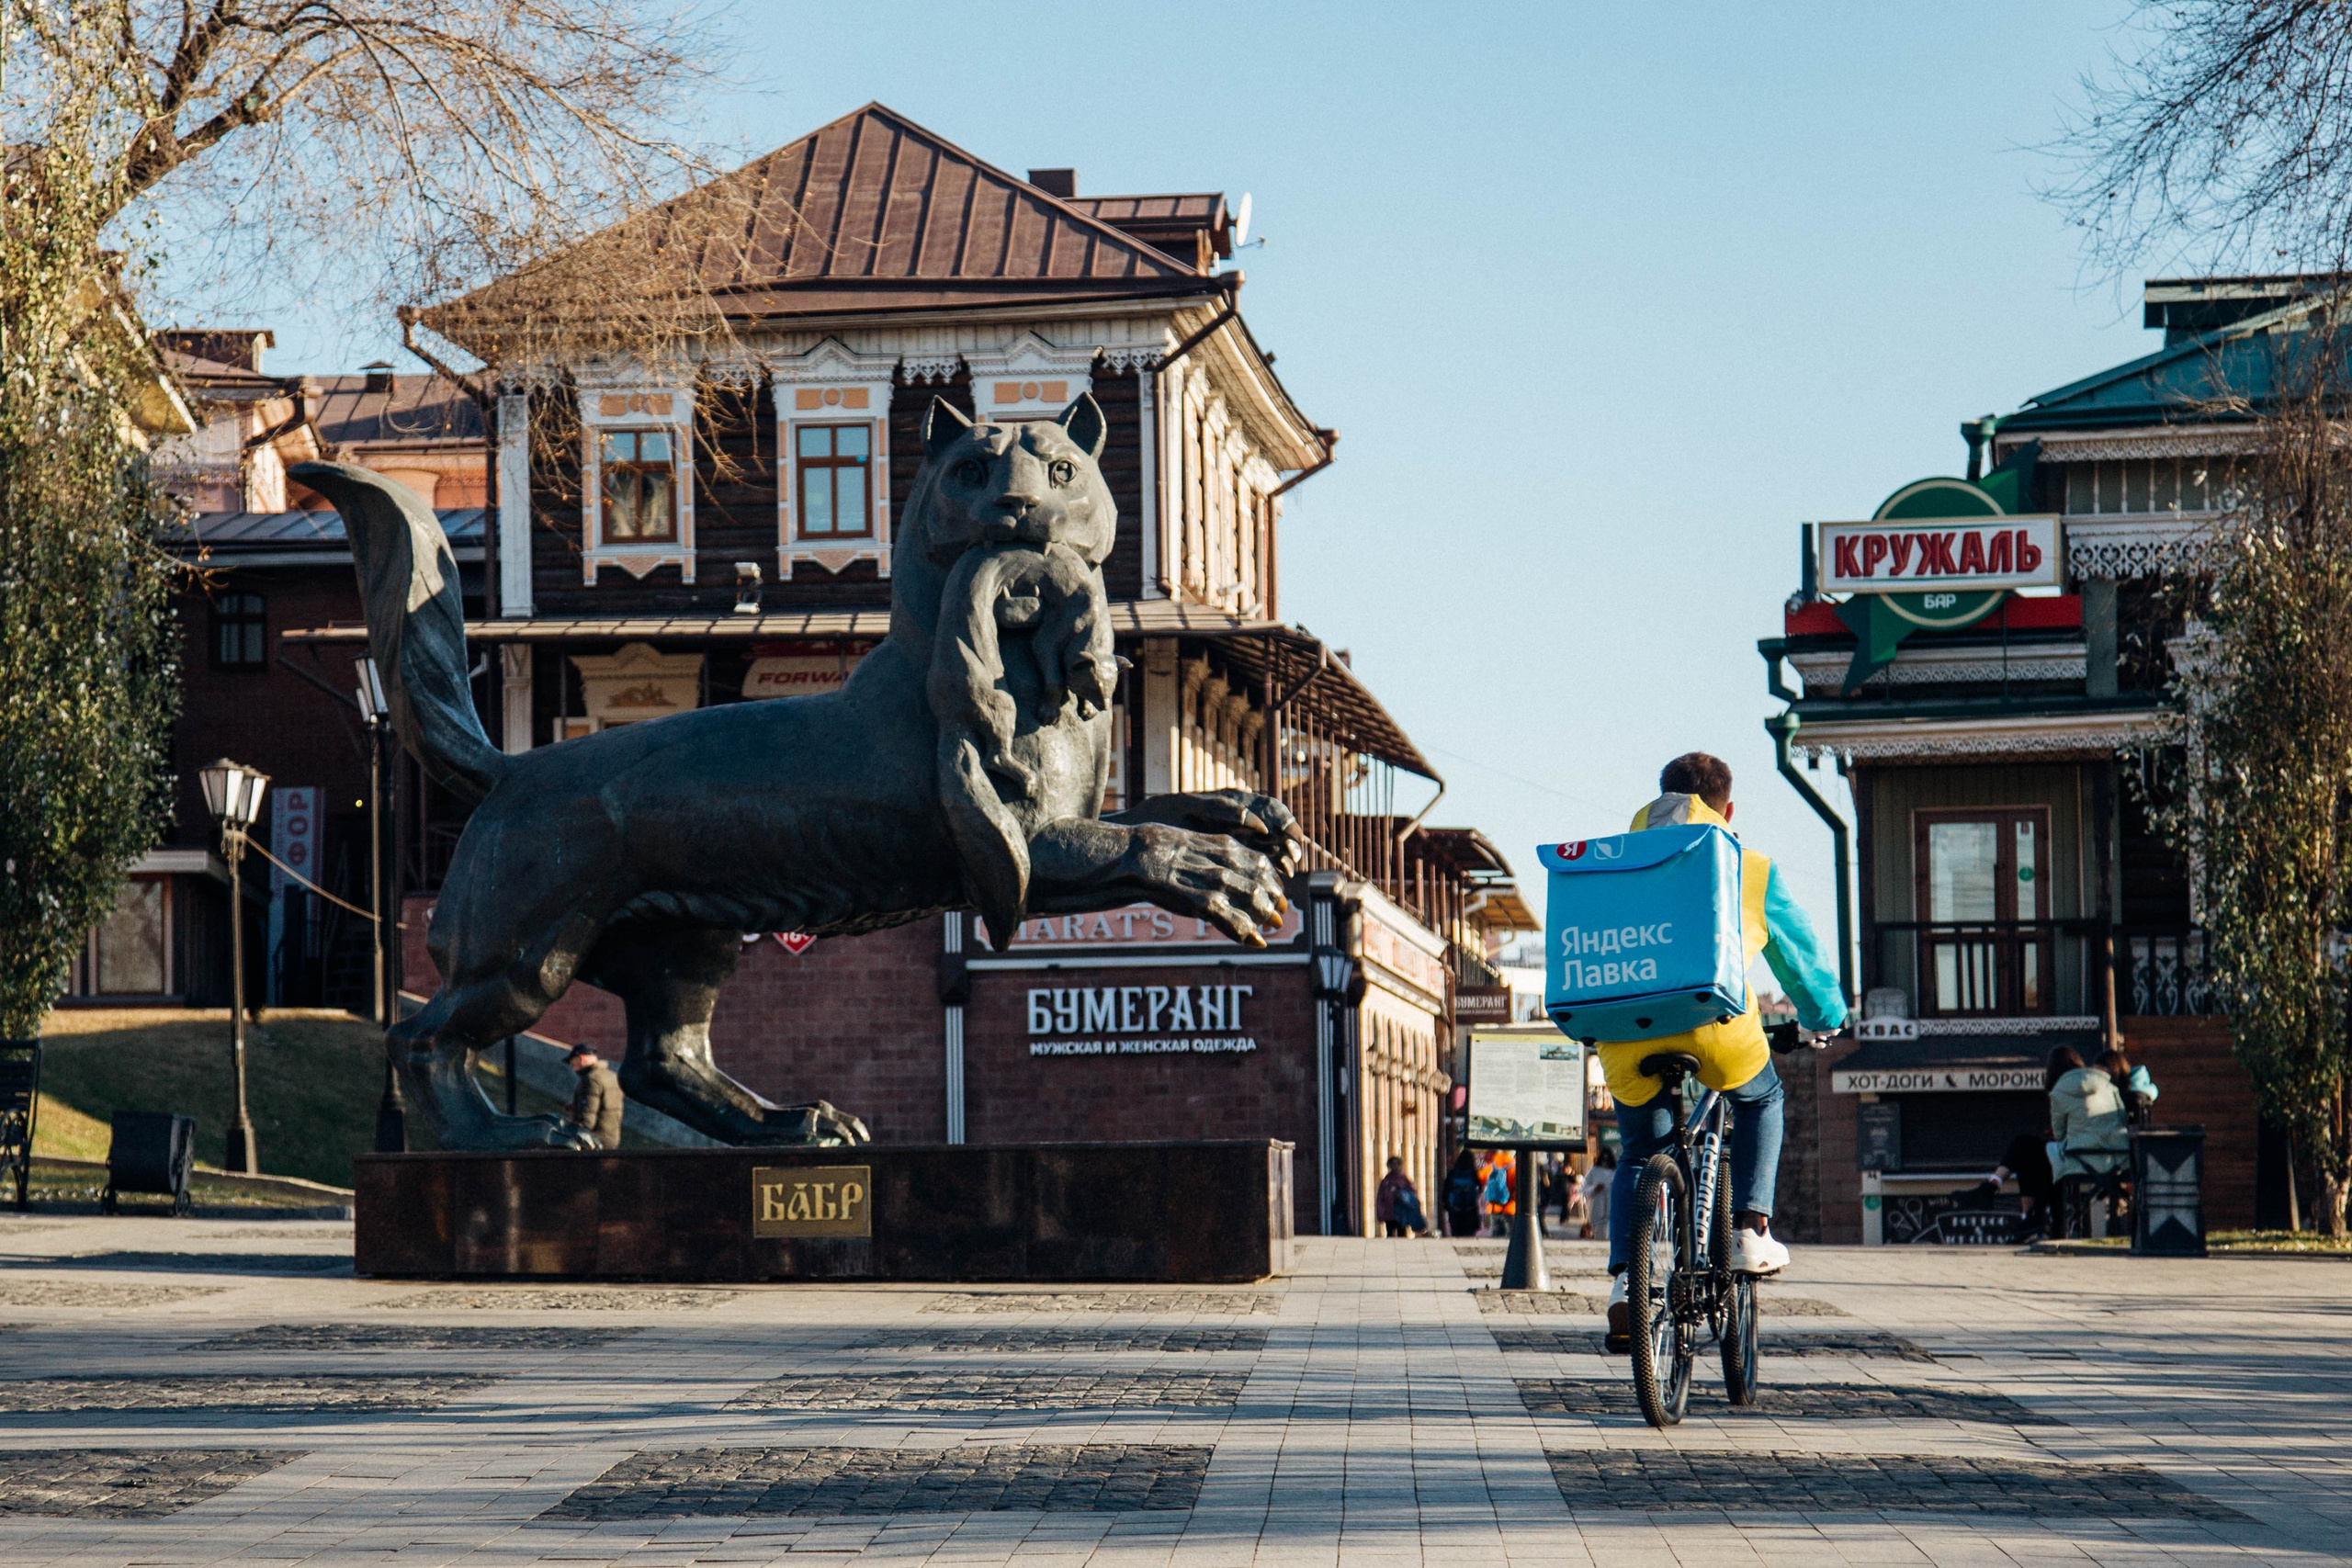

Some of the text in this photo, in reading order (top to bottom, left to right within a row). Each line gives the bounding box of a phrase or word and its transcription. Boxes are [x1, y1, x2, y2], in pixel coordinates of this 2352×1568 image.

[1835, 530, 2041, 578] КРУЖАЛЬ
[1924, 594, 1956, 609] БАР
[1561, 923, 1672, 956] Яндекс
[1562, 958, 1657, 990] Лавка
[1027, 985, 1253, 1034] БУМЕРАНГ
[1030, 1037, 1256, 1055] МУЖСКАЯ И ЖЕНСКАЯ ОДЕЖДА
[1860, 1025, 1913, 1036] КВАС
[1849, 1075, 1933, 1090] ХОТ-ДОГИ
[760, 1182, 864, 1222] БАБР
